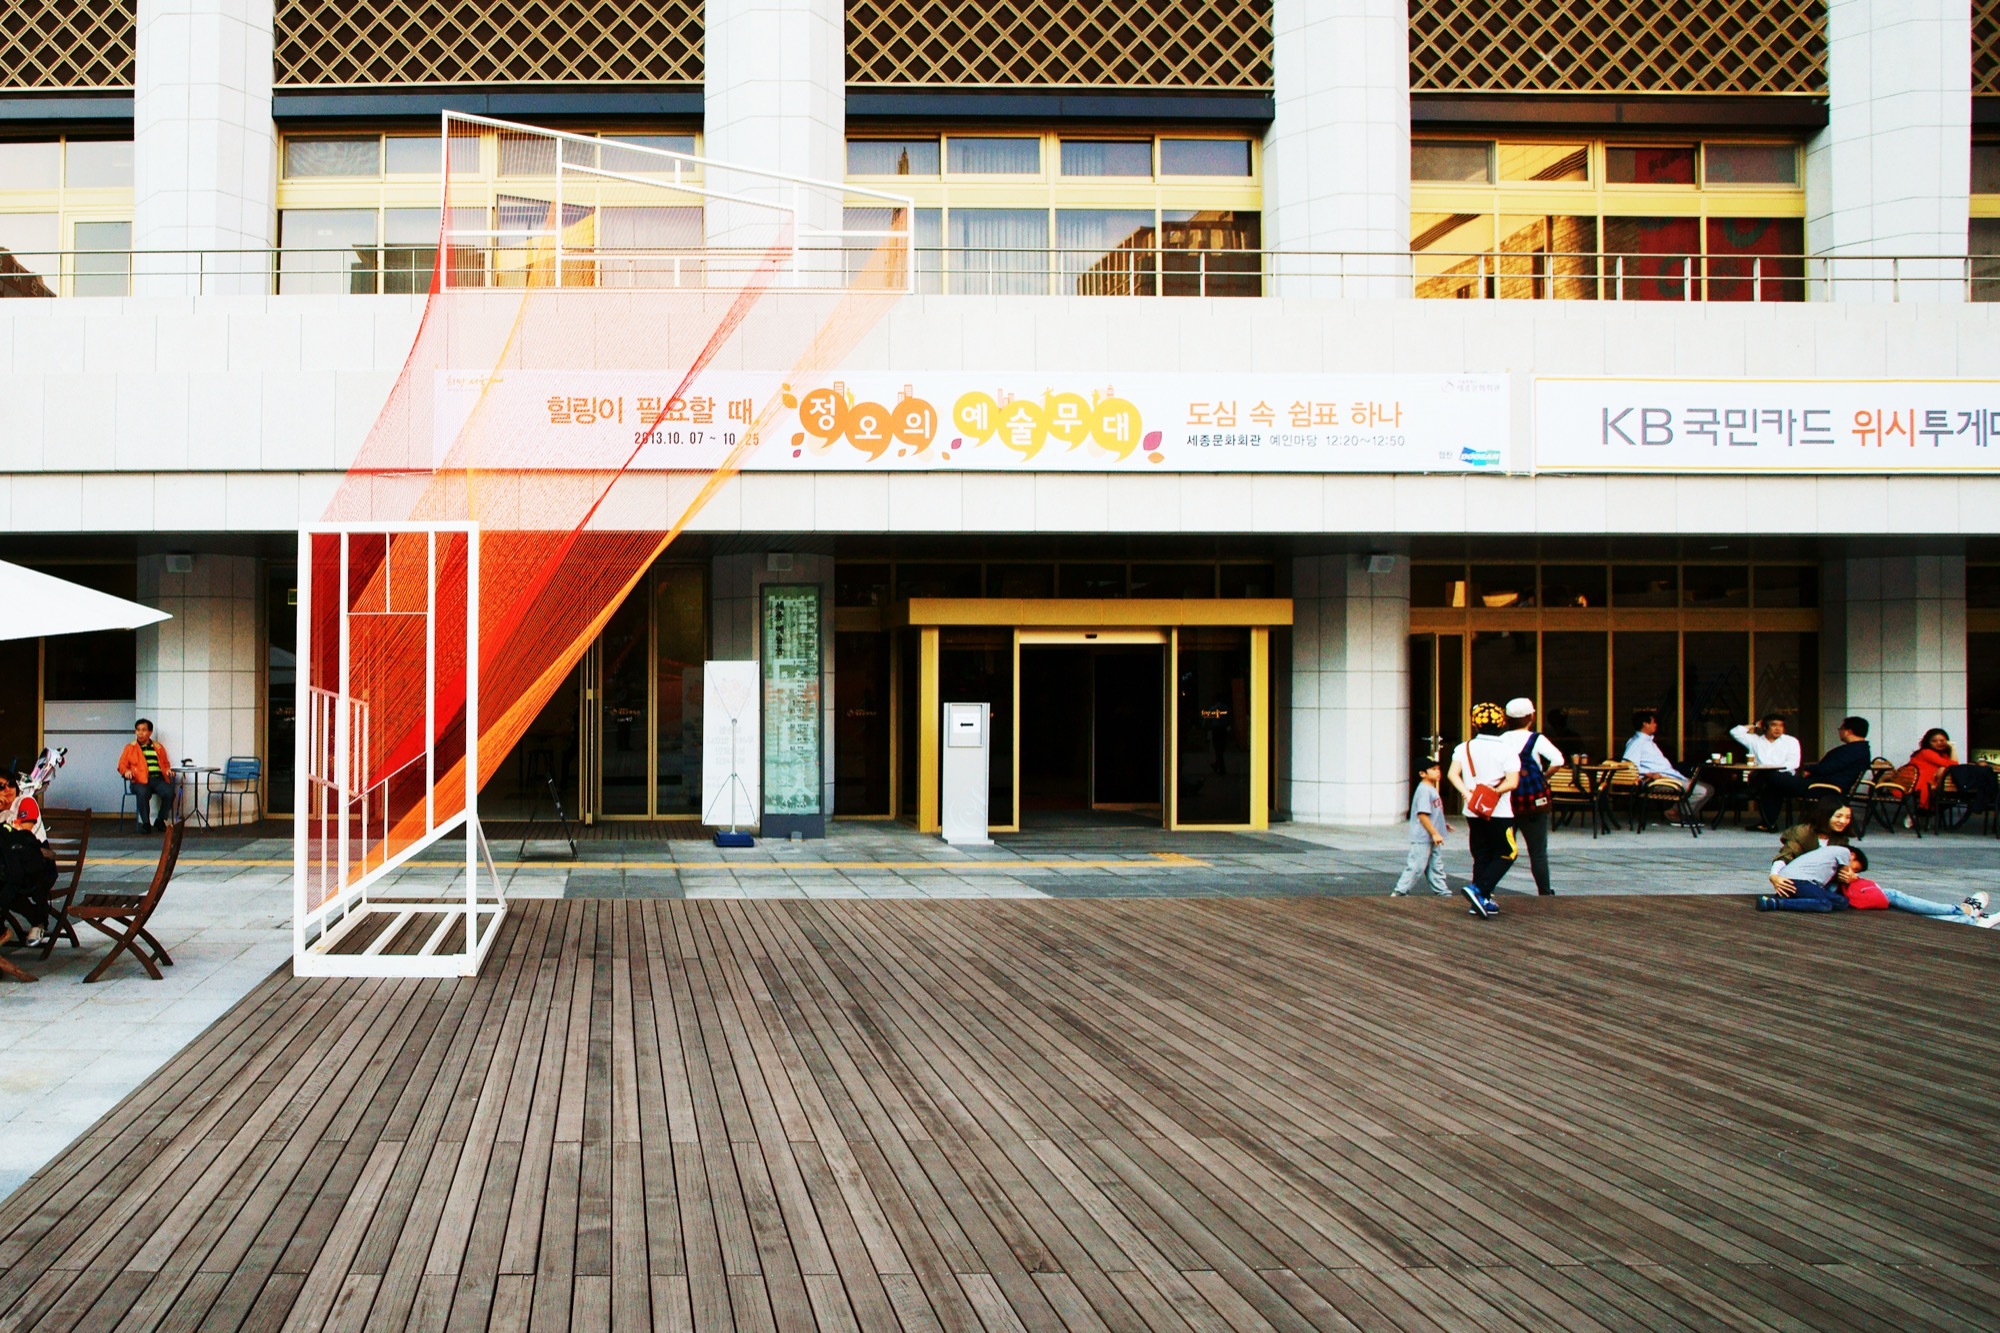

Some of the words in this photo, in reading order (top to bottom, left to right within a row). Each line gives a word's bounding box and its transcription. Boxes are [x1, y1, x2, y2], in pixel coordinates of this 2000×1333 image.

[547, 396, 624, 424] 힐링이
[635, 396, 716, 424] 필요할
[727, 397, 753, 425] 때
[809, 395, 932, 439] 정오의
[960, 402, 1131, 446] 예술무대
[1186, 401, 1238, 428] 도심
[1249, 402, 1276, 428] 속
[1287, 401, 1340, 428] 쉼표
[1350, 401, 1403, 428] 하나
[689, 431, 704, 445] 07
[1186, 433, 1262, 448] 세종문화회관
[1269, 433, 1318, 448] 예인마당
[1601, 407, 1675, 446] KB
[1682, 407, 1836, 447] 국민카드
[1851, 408, 2000, 448] 위시투게
